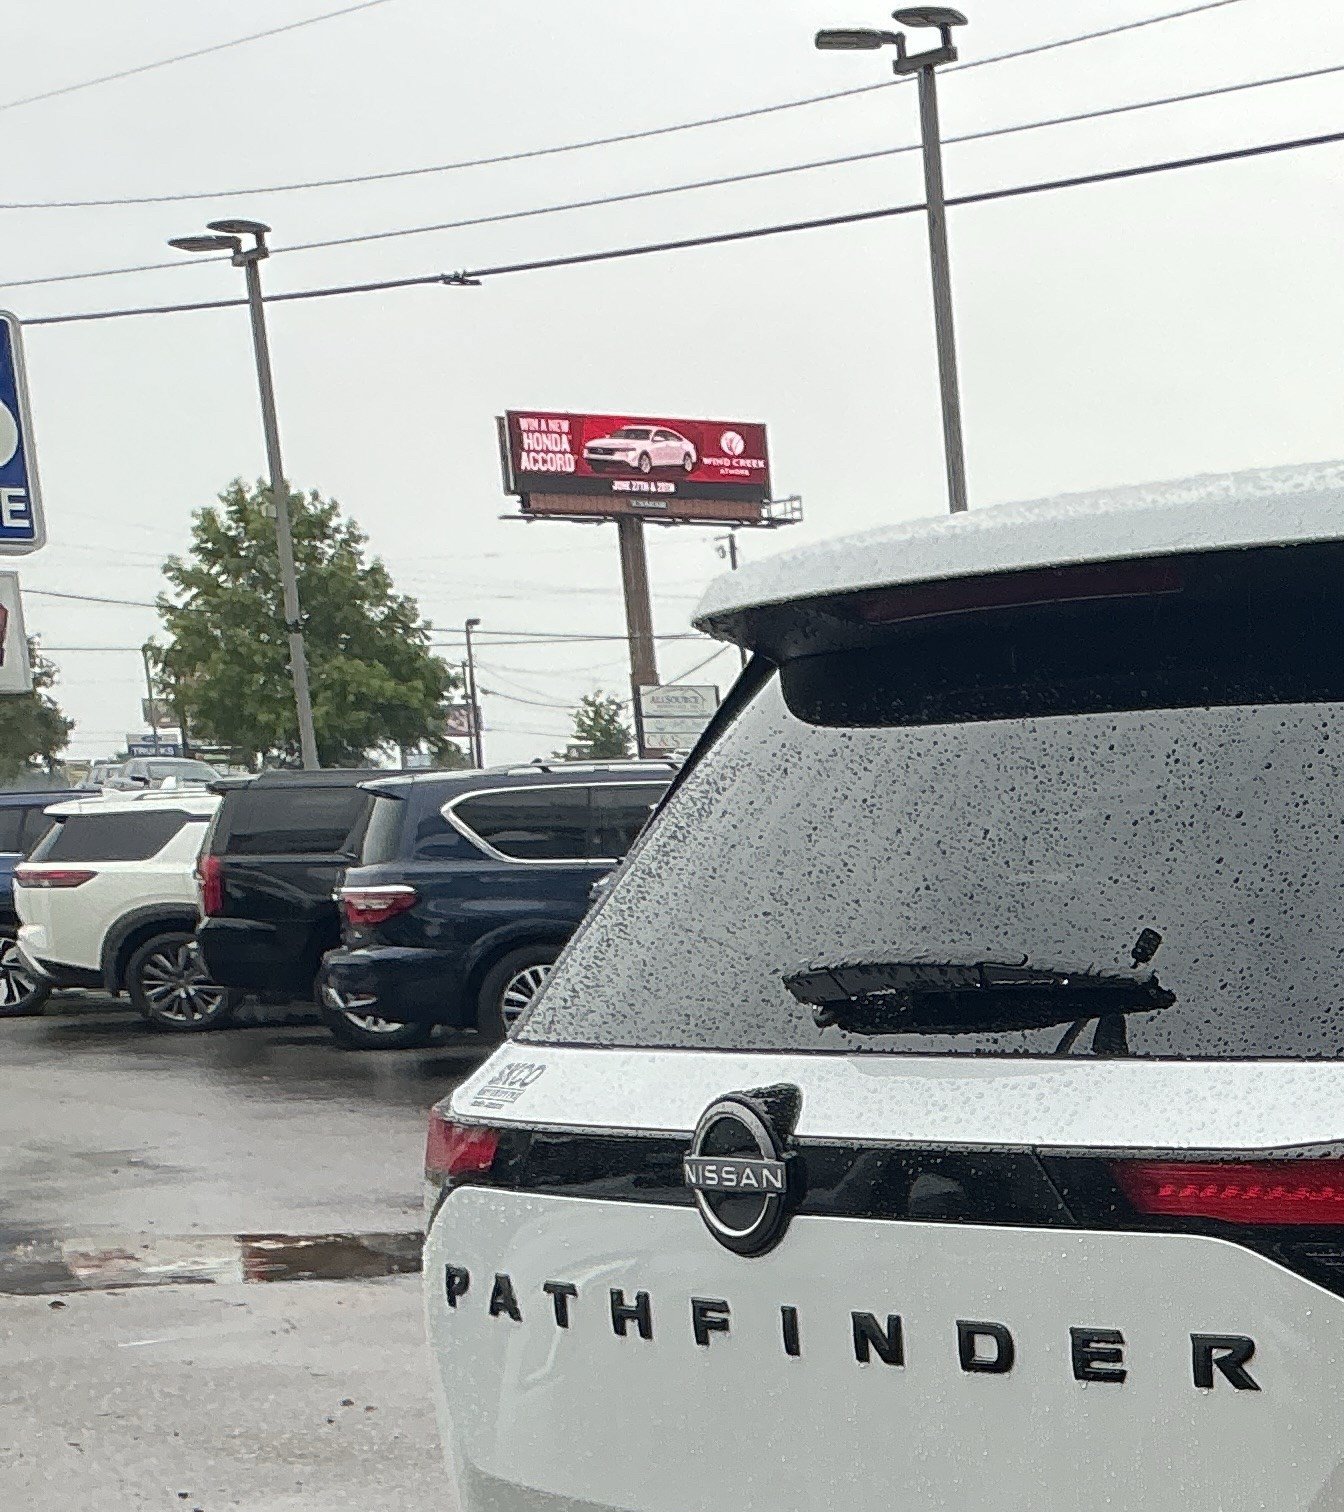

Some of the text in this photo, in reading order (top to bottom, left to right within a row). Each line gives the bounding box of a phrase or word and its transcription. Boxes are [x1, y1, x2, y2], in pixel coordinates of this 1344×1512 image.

[548, 419, 569, 432] NEW
[522, 431, 571, 452] HONDA
[521, 451, 576, 473] ACCORD
[684, 1163, 783, 1189] NISSAN
[444, 1263, 1262, 1392] PATHFINDER
